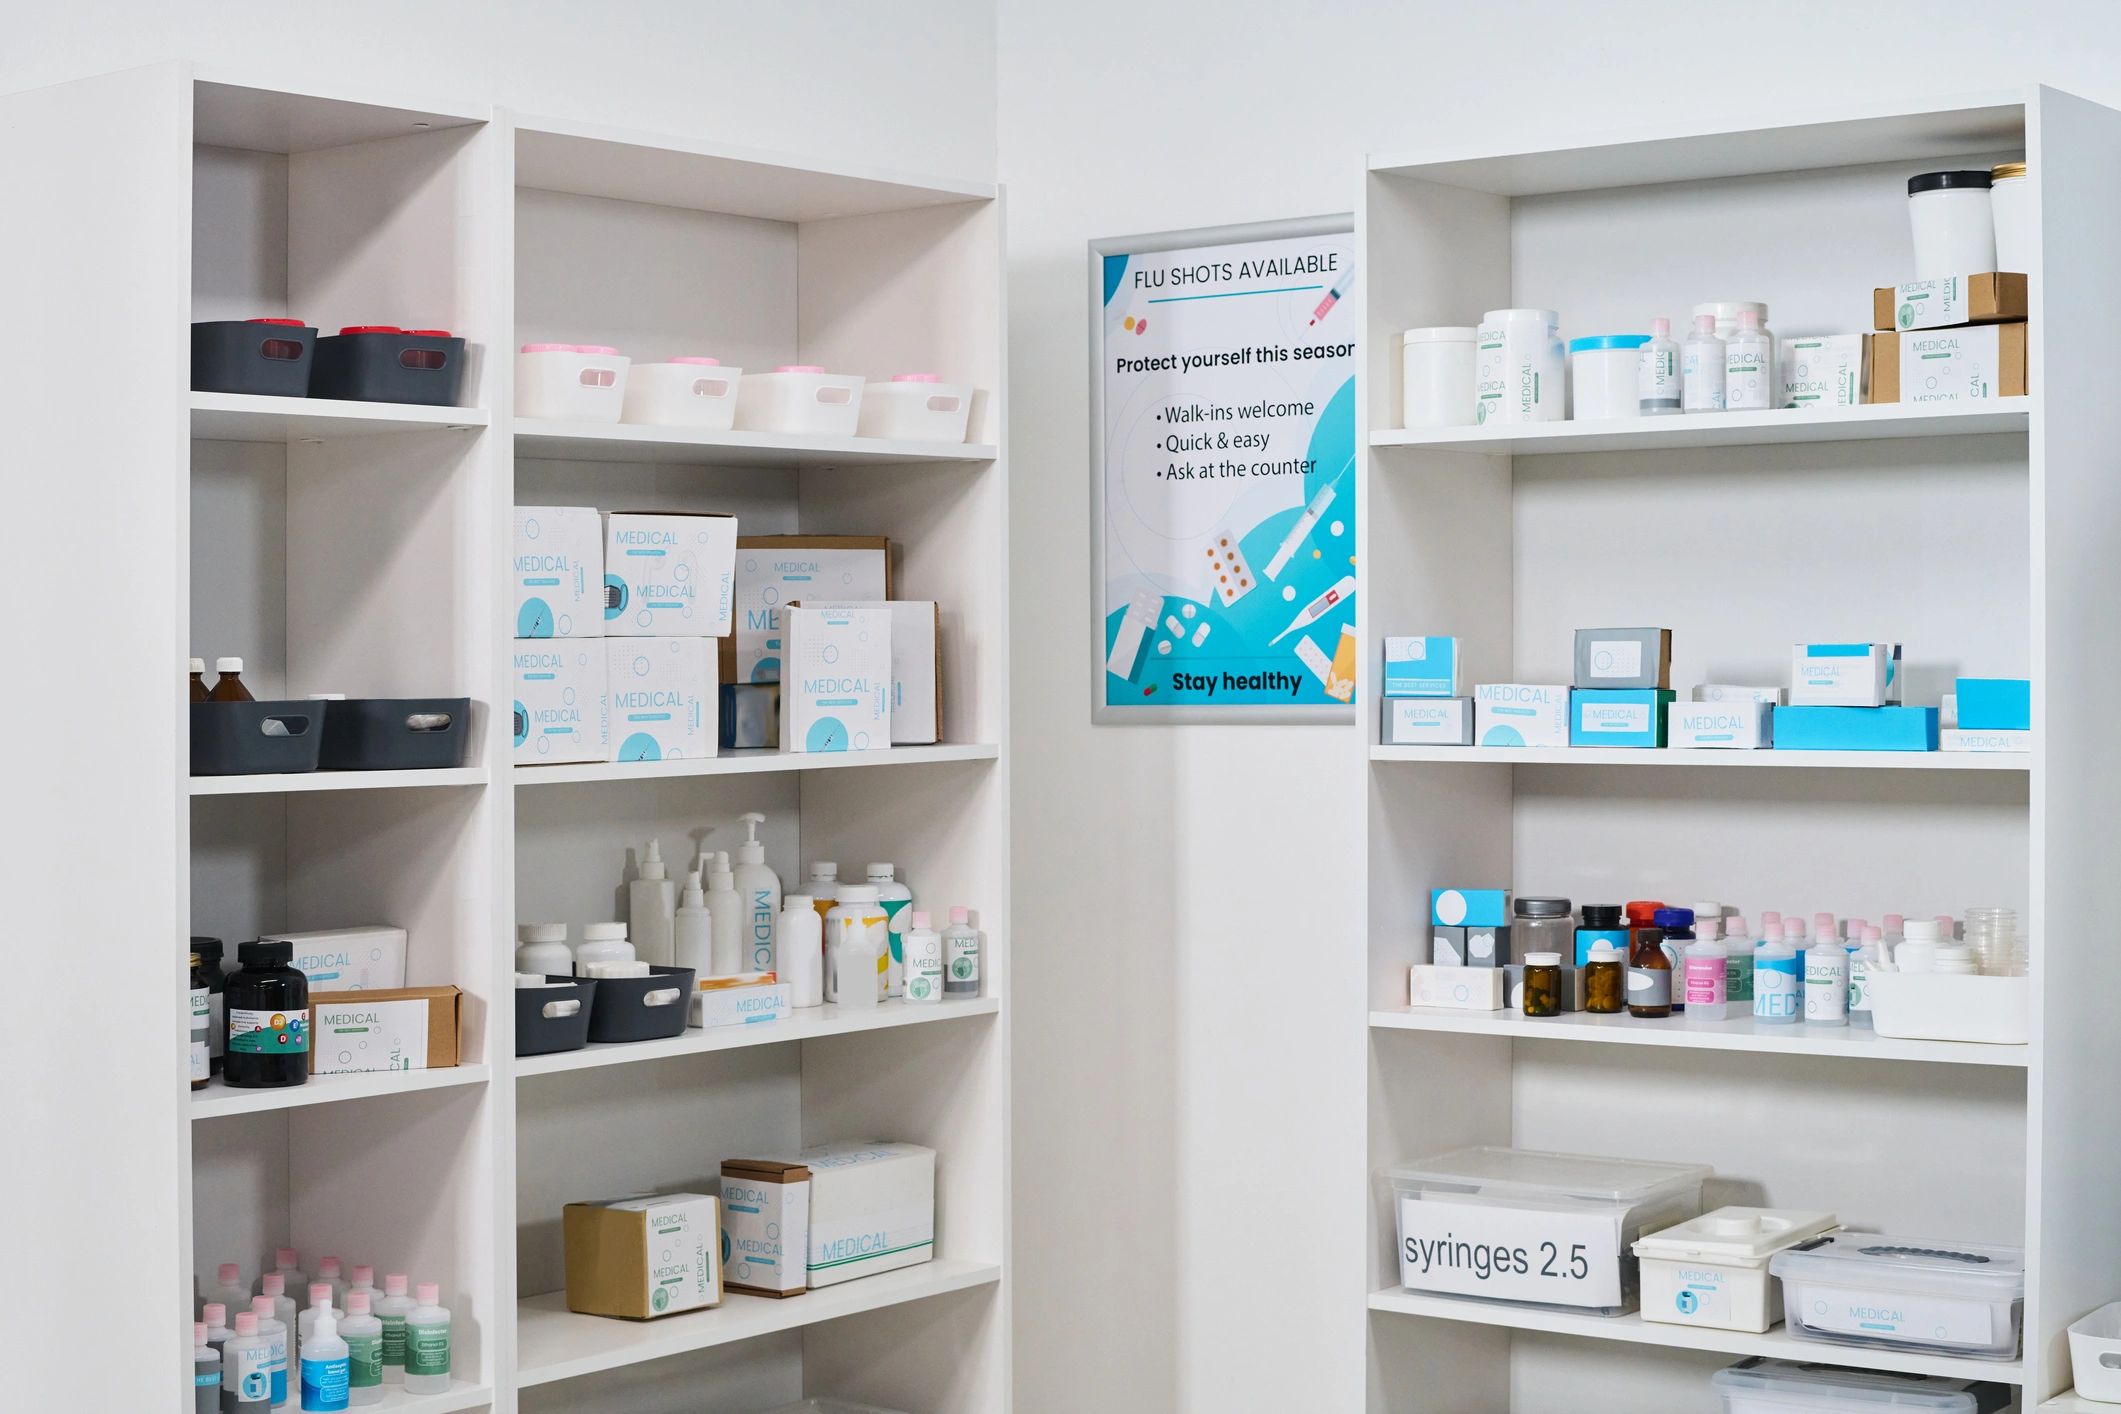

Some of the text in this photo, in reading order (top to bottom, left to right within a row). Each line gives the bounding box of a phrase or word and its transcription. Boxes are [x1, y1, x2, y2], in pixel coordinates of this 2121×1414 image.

[1134, 253, 1338, 289] FLU SHOTS AVAILABLE
[1901, 279, 1937, 293] MEDICAL
[1912, 338, 1961, 352] MEDICAL
[1117, 354, 1177, 374] Protect
[1182, 348, 1251, 374] yourself
[1256, 345, 1288, 364] this
[1521, 362, 1532, 413] MEDICAL
[1785, 380, 1829, 393] MEDICAL
[1165, 400, 1315, 424] Walk-ins welcome
[1166, 431, 1271, 454] Quick & easy
[1166, 458, 1317, 481] Ask at the counter
[615, 530, 679, 546] MEDICAL
[513, 555, 571, 573] MEDICAL
[774, 562, 822, 573] MEDICAL
[636, 584, 697, 599] MEDICAL
[718, 571, 731, 622] MEDICAL
[514, 654, 565, 669] MEDICAL
[1801, 666, 1841, 678] MEDICAL
[803, 678, 870, 695] MEDICAL
[1172, 671, 1303, 697] Stay healthy
[615, 691, 684, 709] MEDICAL
[1479, 685, 1552, 705] MEDICAL
[534, 709, 582, 723] MEDICAL
[1404, 708, 1449, 720] MEDICAL
[1592, 709, 1638, 720] MEDICAL
[1683, 716, 1744, 730] MEDICAL
[1959, 736, 2012, 748] MEDICAL
[754, 890, 771, 972] MEDIC
[291, 952, 351, 971] MEDICAL
[736, 996, 785, 1012] MEDICAL
[324, 1013, 380, 1026] MEDICAL
[721, 1187, 769, 1205] MEDICAL
[651, 1213, 688, 1228] MEDICAL
[736, 1238, 784, 1256] MEDICAL
[822, 1231, 889, 1261] MEDICAL
[1405, 1233, 1589, 1280] syringes 2.5
[653, 1264, 690, 1279] MEDICAL
[696, 1243, 704, 1294] MEDICAL
[1678, 1270, 1725, 1283] MEDICAL
[1849, 1306, 1905, 1322] MEDICAL
